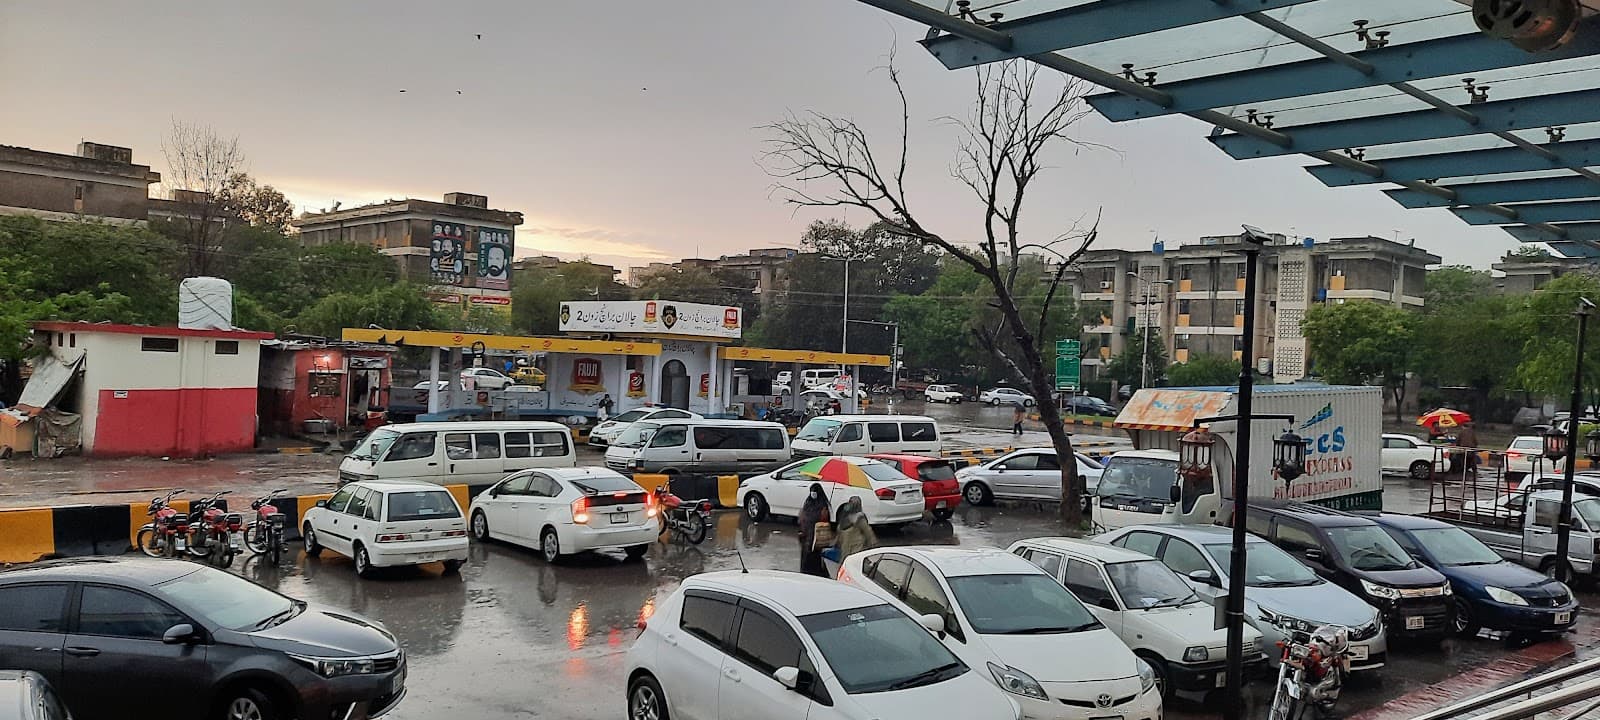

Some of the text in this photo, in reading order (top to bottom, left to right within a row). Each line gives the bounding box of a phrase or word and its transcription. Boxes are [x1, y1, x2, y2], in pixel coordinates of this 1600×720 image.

[577, 310, 583, 321] 2
[583, 311, 599, 322] زون
[616, 311, 637, 327] چالان
[679, 312, 684, 321] 2
[706, 315, 720, 327] چالان
[577, 363, 597, 377] FAUJI
